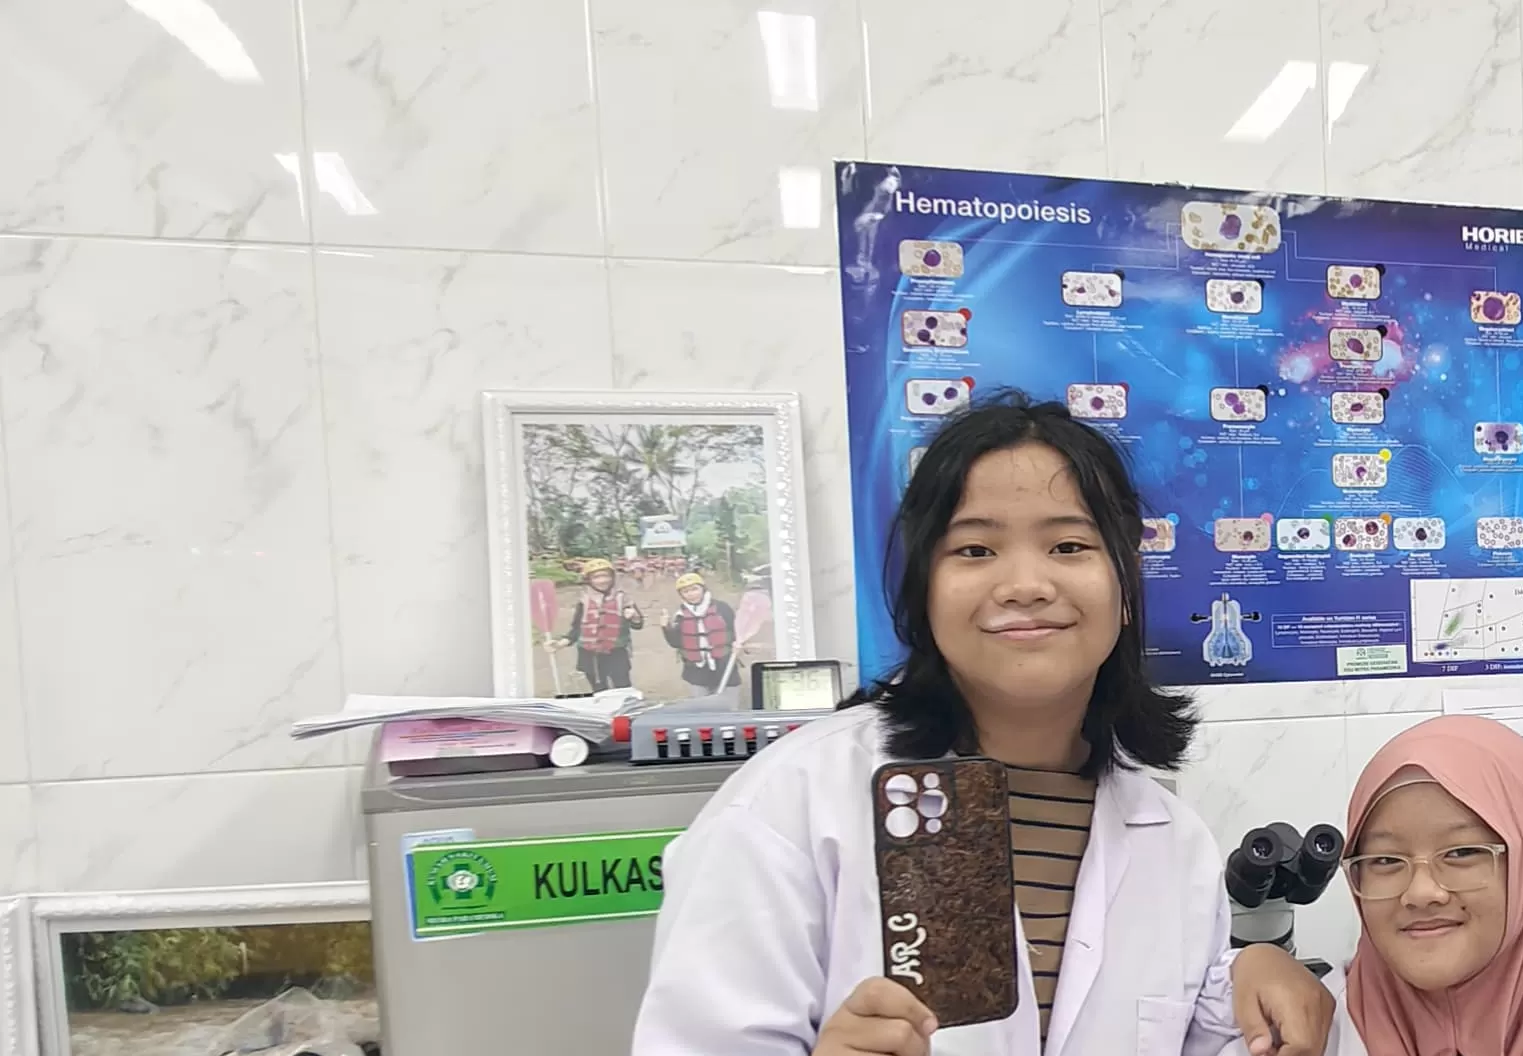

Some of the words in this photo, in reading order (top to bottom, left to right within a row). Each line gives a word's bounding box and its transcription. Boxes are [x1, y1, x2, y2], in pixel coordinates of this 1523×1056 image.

[895, 191, 1092, 225] Hematopoiesis
[1465, 242, 1509, 252] Medical
[533, 855, 664, 900] KULKAS
